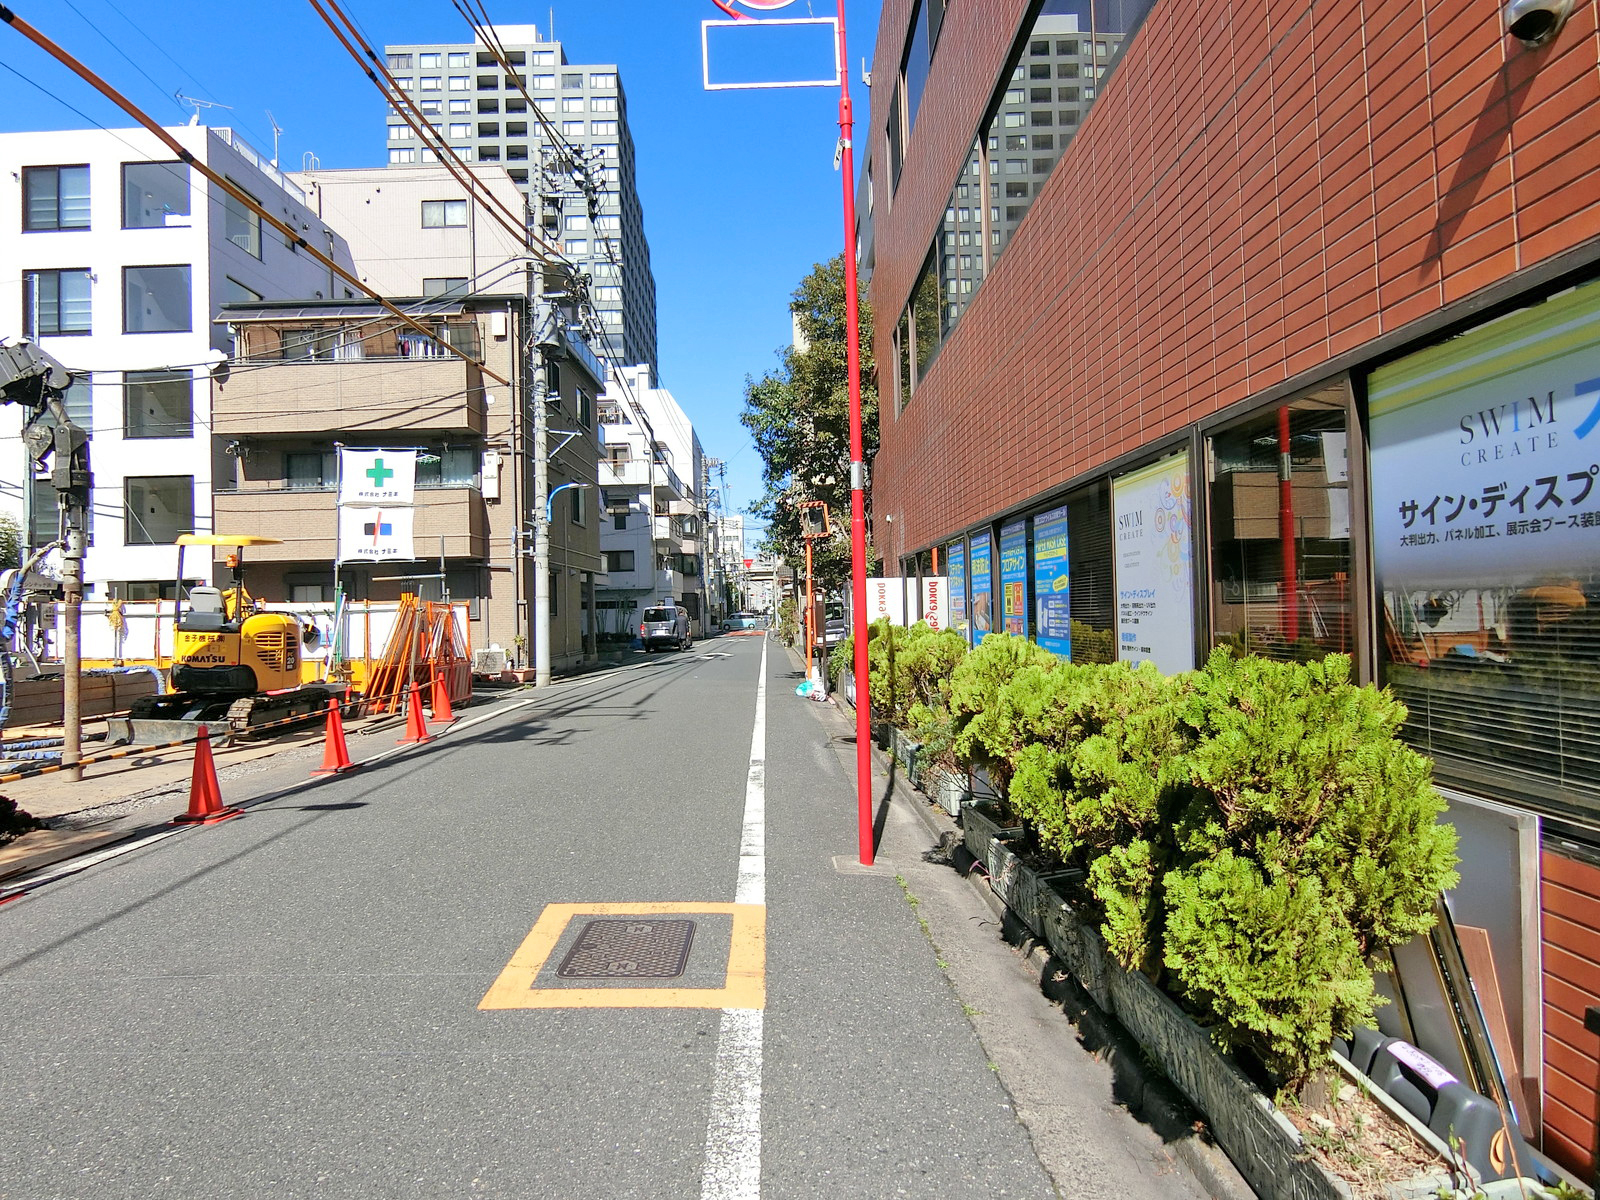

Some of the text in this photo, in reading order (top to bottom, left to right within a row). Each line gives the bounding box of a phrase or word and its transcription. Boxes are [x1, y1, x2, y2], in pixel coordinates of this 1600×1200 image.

[1460, 391, 1557, 445] SWIM
[1461, 432, 1559, 466] CREATE
[1398, 463, 1600, 529] サイン・ディスプ
[1118, 510, 1143, 530] SWIM
[1119, 528, 1143, 541] CREATE
[181, 653, 226, 664] KOMATSU
